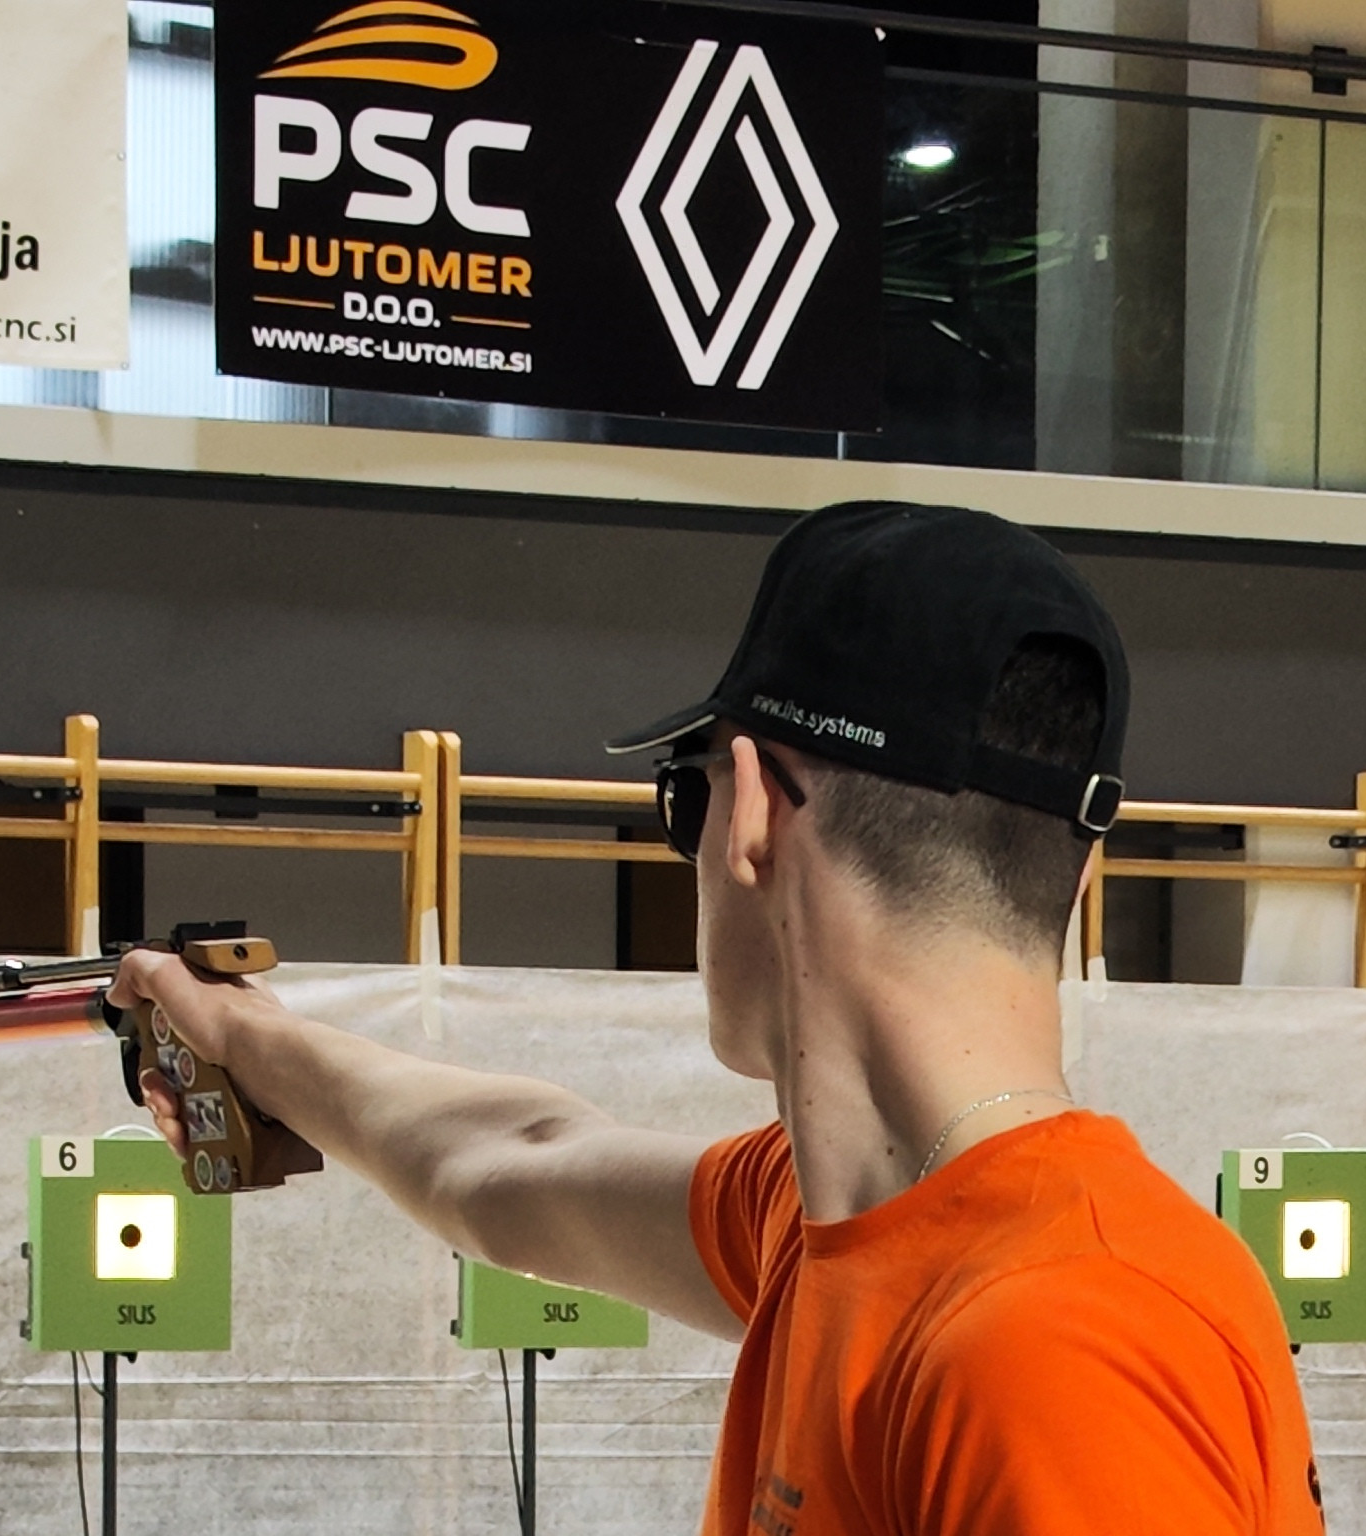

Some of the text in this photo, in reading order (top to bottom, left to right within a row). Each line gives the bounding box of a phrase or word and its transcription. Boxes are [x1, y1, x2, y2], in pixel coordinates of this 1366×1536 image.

[253, 94, 532, 238] PSC
[252, 230, 532, 297] LJUTOMER
[343, 292, 441, 328] D.O.O.
[251, 325, 532, 374] WWW.PSC-LJUTOMER.SI
[59, 1141, 77, 1171] 6
[1254, 1156, 1269, 1183] 9
[117, 1304, 156, 1324] SIUS
[543, 1303, 579, 1322] SIUS
[1300, 1301, 1332, 1320] SIUS
